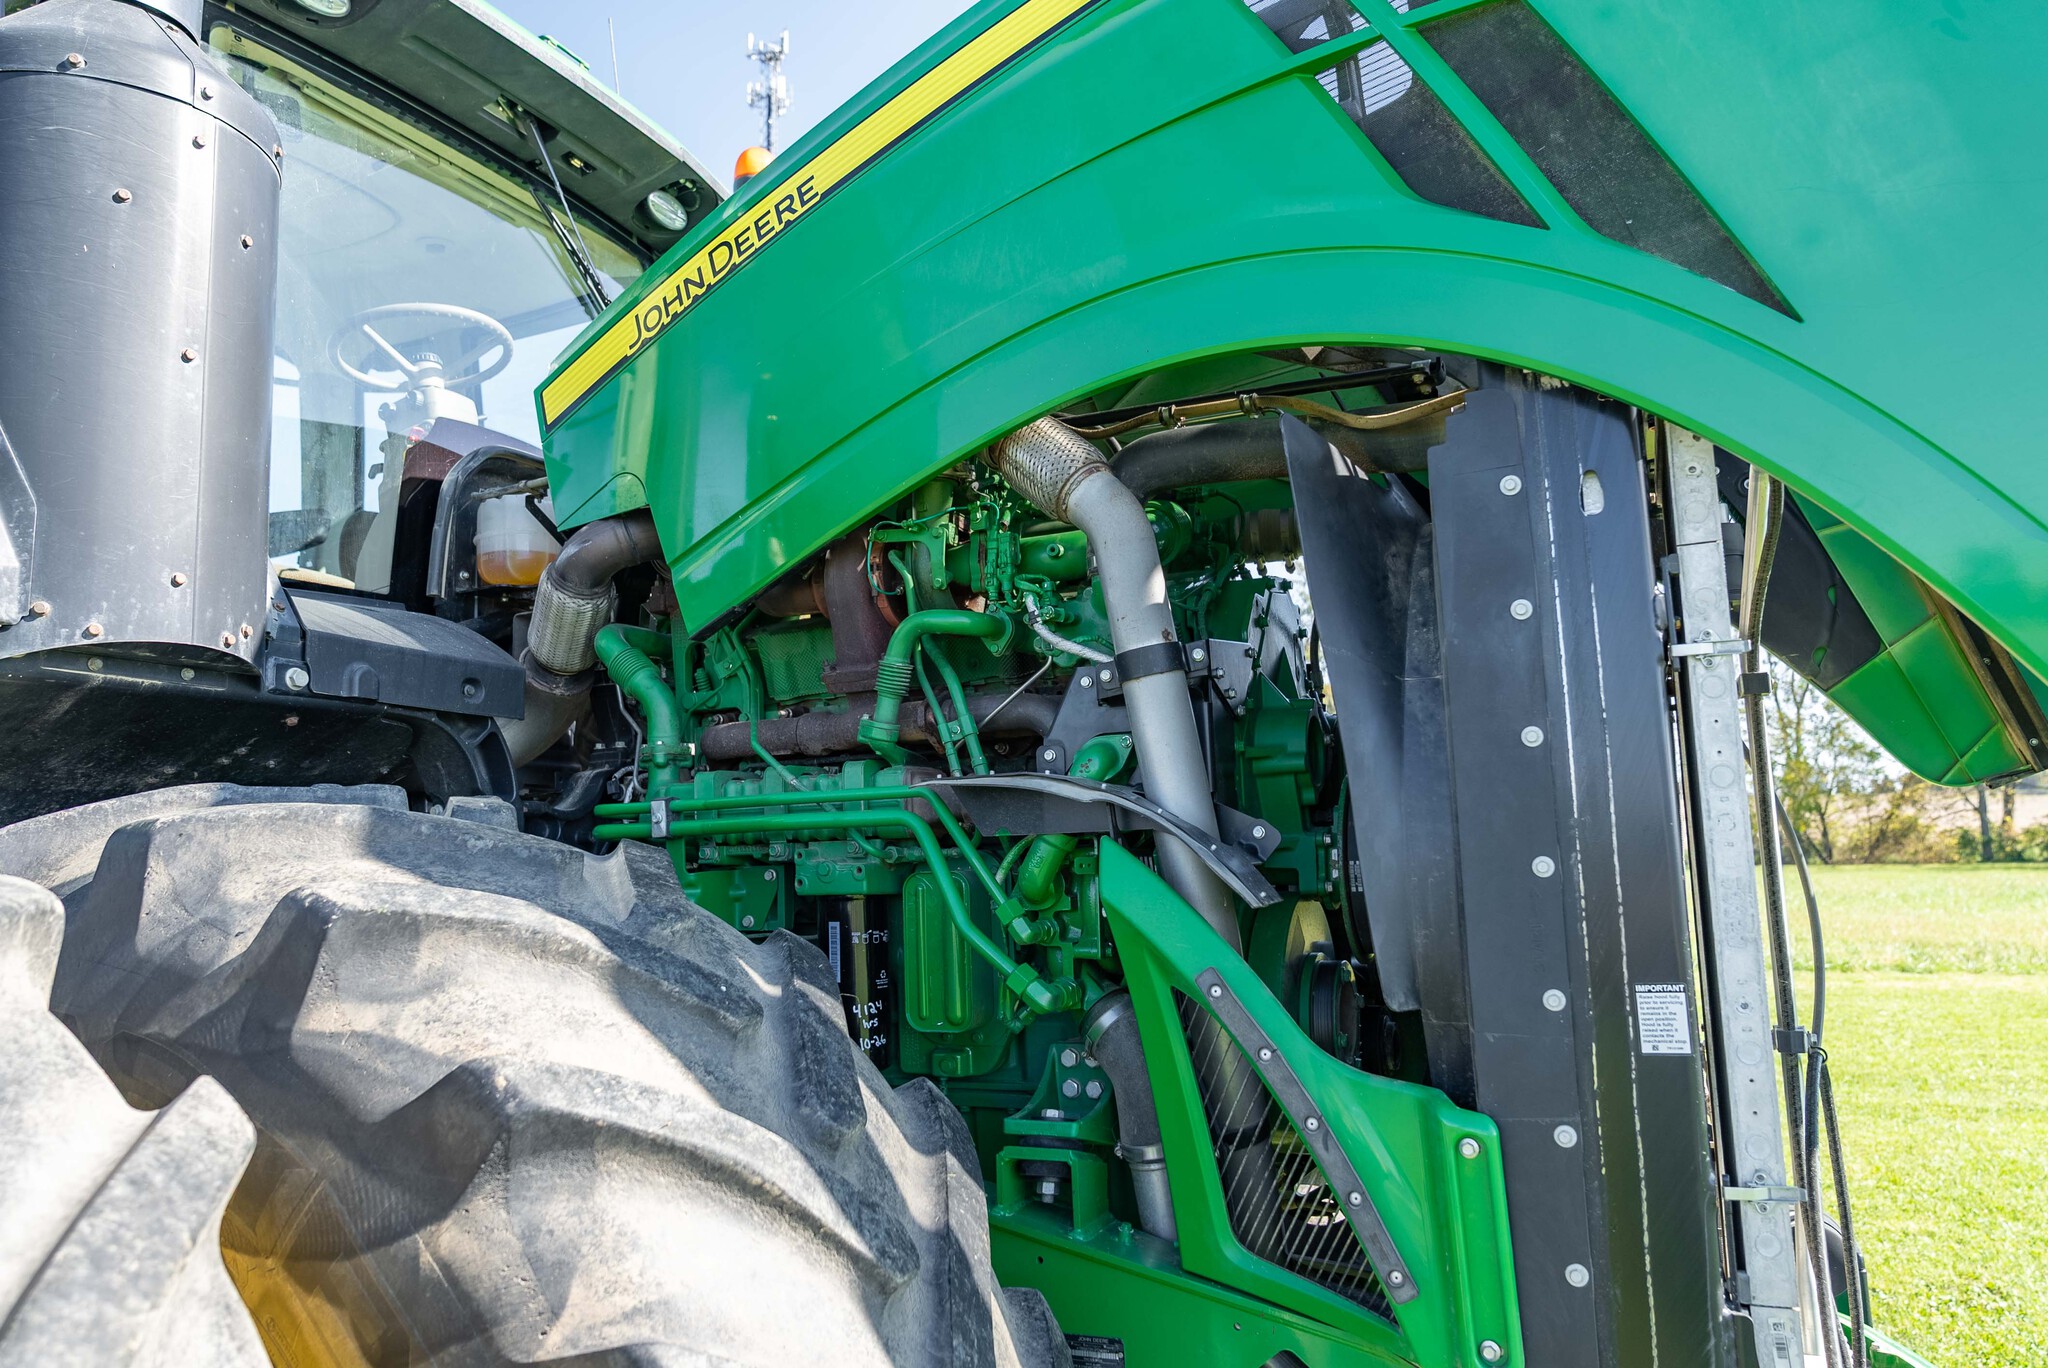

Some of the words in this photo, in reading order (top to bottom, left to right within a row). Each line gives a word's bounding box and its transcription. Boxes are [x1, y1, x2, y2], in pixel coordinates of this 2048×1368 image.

[628, 266, 706, 351] JOHN
[707, 174, 821, 279] DEERE
[1634, 984, 1685, 992] IMPORTANT
[852, 999, 883, 1018] 4124
[862, 1018, 879, 1029] hrs
[859, 1034, 887, 1051] 10-26
